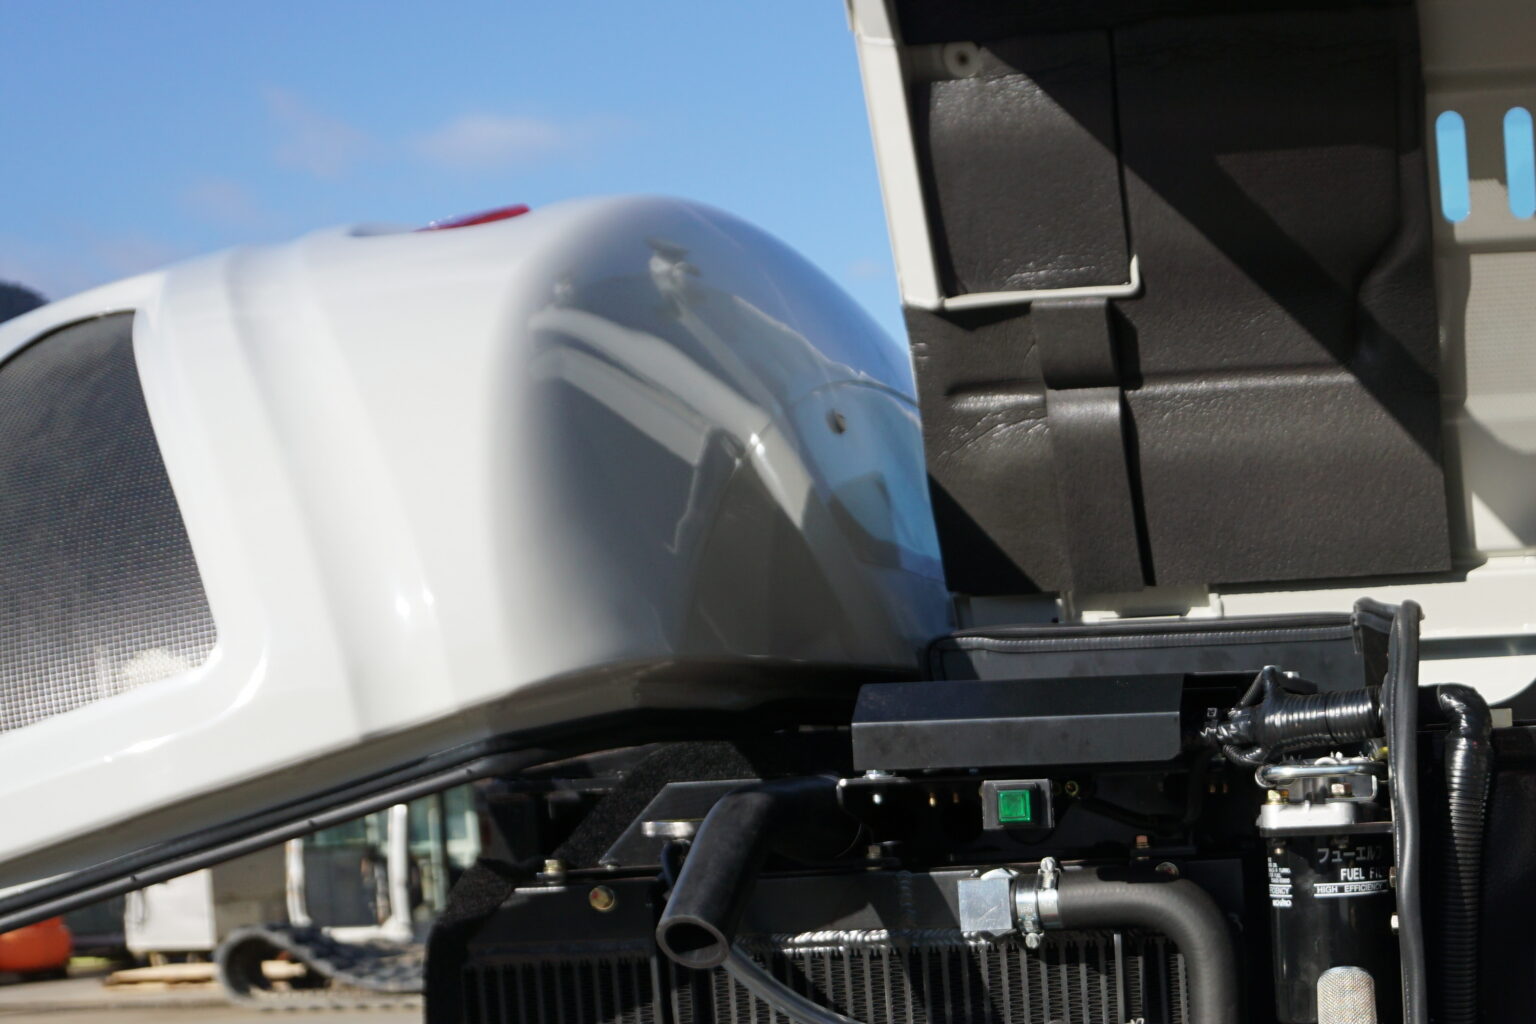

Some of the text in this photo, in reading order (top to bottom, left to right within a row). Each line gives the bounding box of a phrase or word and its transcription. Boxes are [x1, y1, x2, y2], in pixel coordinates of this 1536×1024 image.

[1340, 868, 1366, 881] FUEL
[1316, 882, 1384, 894] HIGH EFFICIENCY
